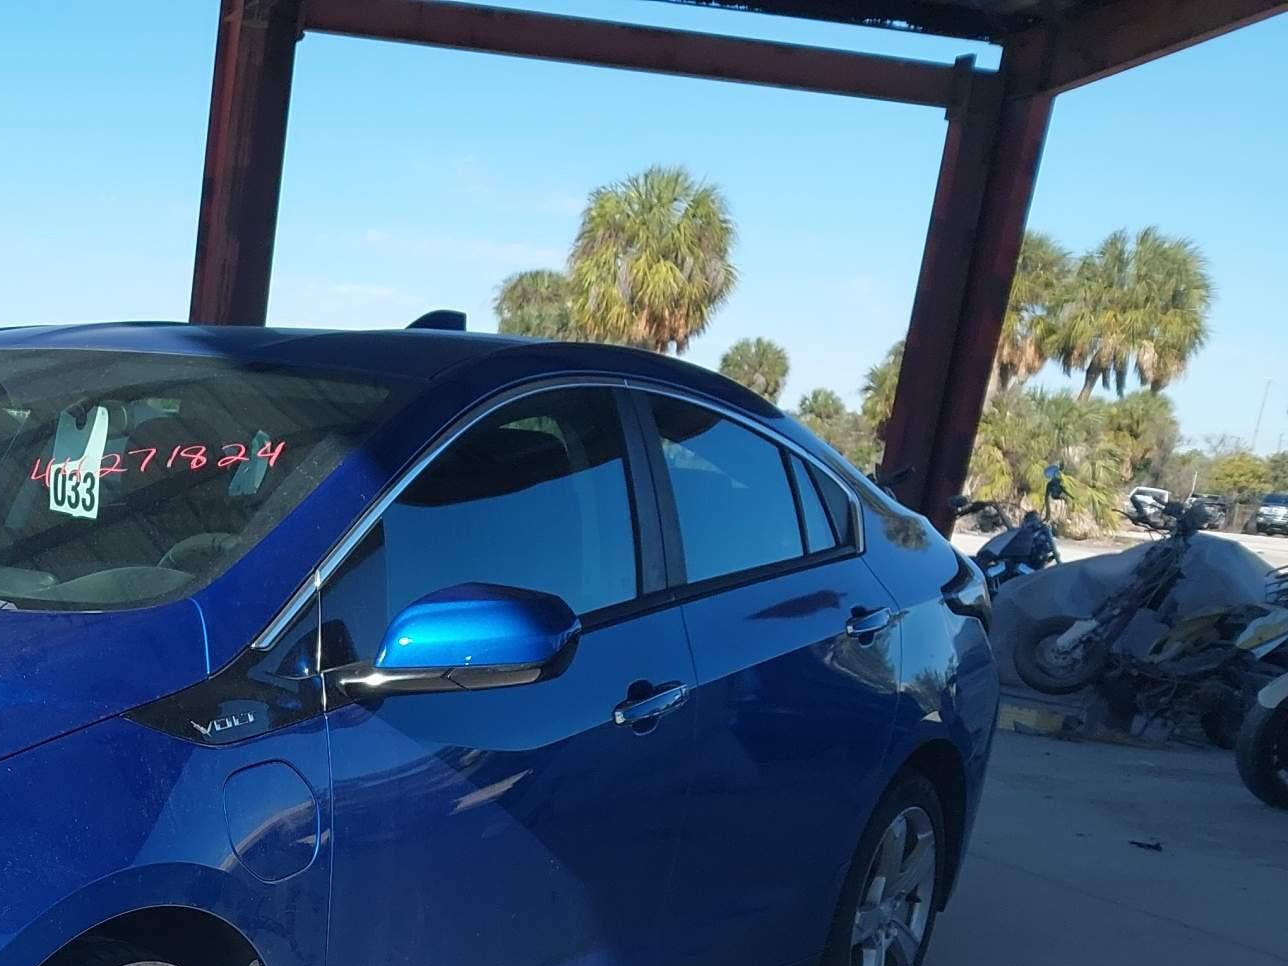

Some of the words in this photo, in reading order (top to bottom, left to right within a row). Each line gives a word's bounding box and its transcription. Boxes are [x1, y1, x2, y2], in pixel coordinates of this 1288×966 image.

[30, 441, 286, 487] 44271824
[53, 466, 97, 512] 033
[190, 711, 256, 737] VOLT
